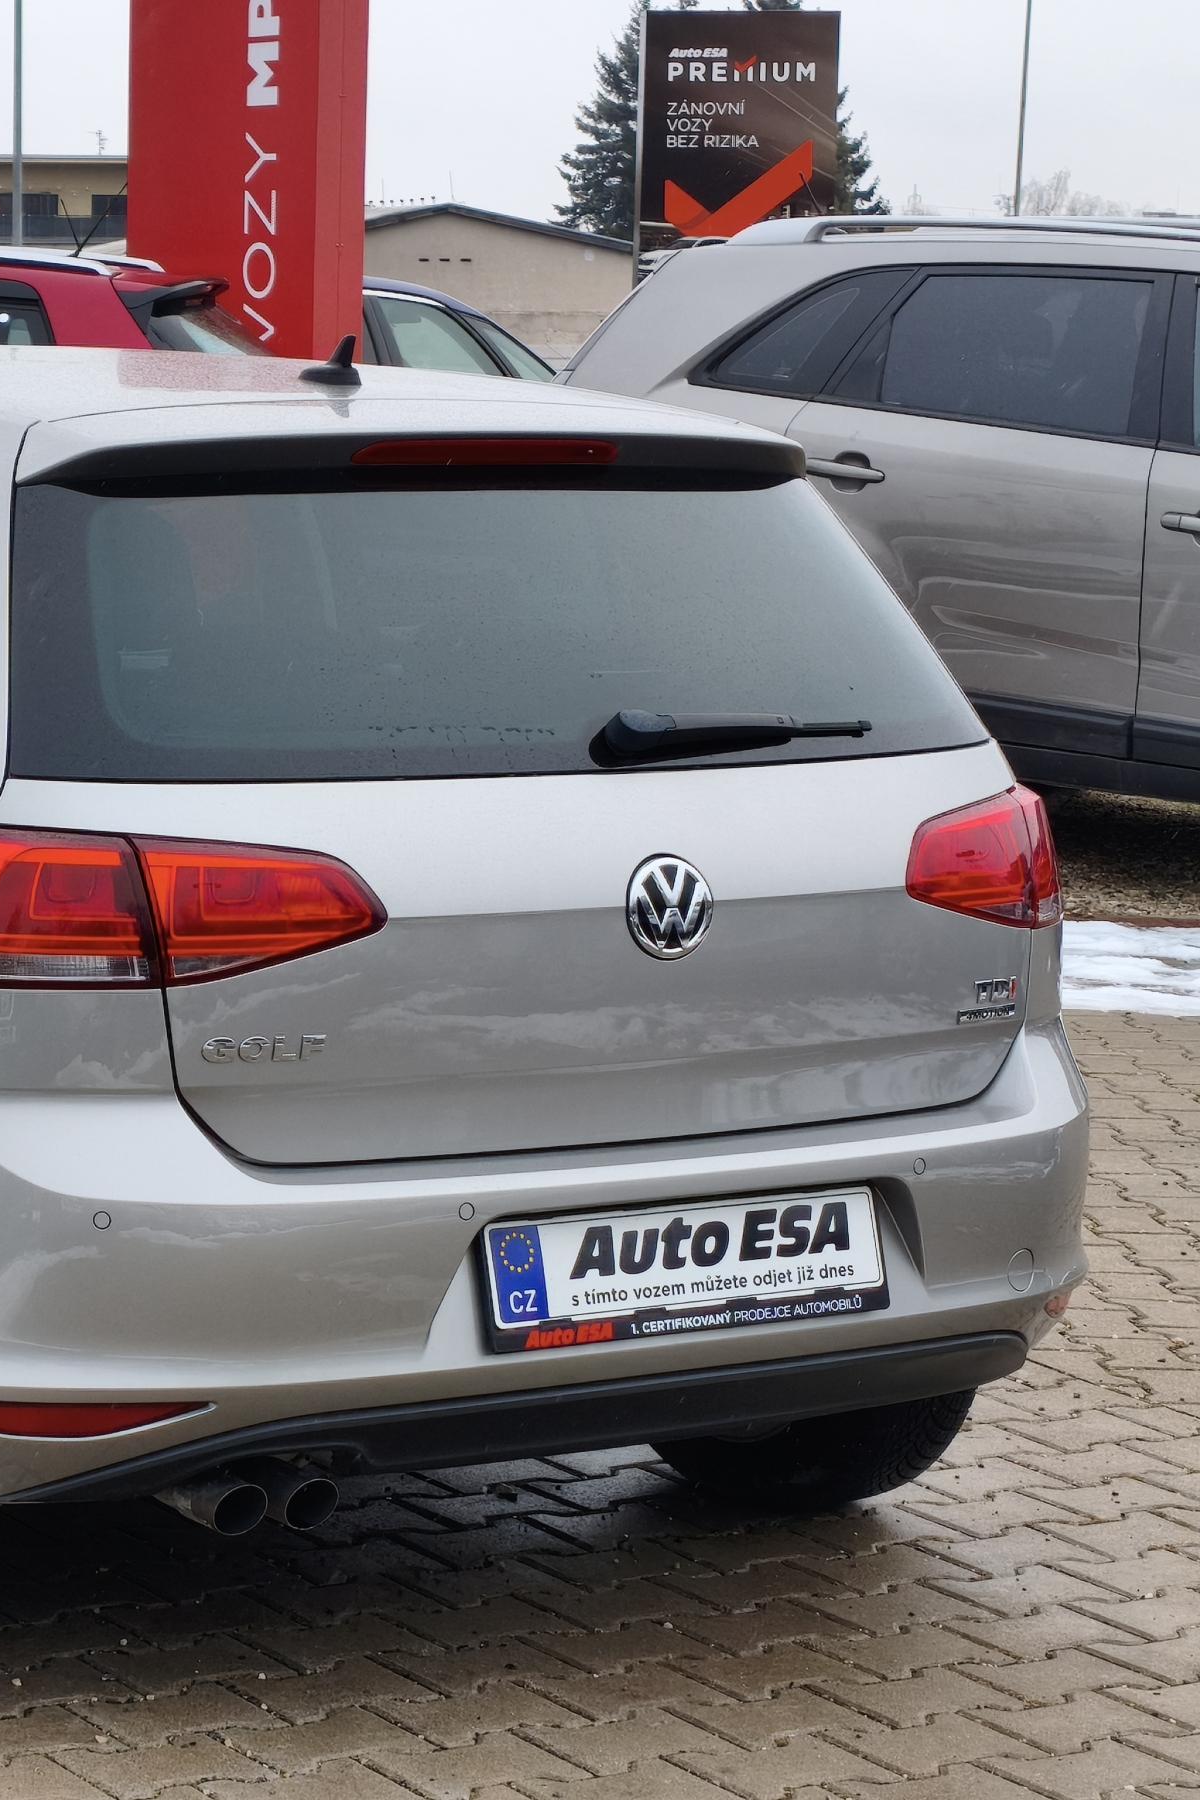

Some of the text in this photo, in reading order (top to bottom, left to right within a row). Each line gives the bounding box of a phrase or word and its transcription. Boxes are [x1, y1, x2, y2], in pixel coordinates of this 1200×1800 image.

[702, 47, 728, 58] ESA
[667, 60, 816, 82] PREMIUM
[666, 98, 746, 115] ZÁNOVNÍ
[666, 118, 713, 132] VOZY
[666, 135, 760, 148] BEZ RIZIKA
[243, 131, 277, 342] VOZY
[632, 858, 708, 955] VW
[201, 1034, 328, 1065] GOLF
[569, 1201, 850, 1280] Auto ESA
[571, 1263, 855, 1307] s tímto vozem můžete odjet již dnes
[509, 1289, 538, 1314] CZ
[630, 1295, 862, 1335] 1. CERTIFIKOVANÝ PRODEJCE AUTOMOBILŮ
[525, 1320, 614, 1349] Auto ESA
